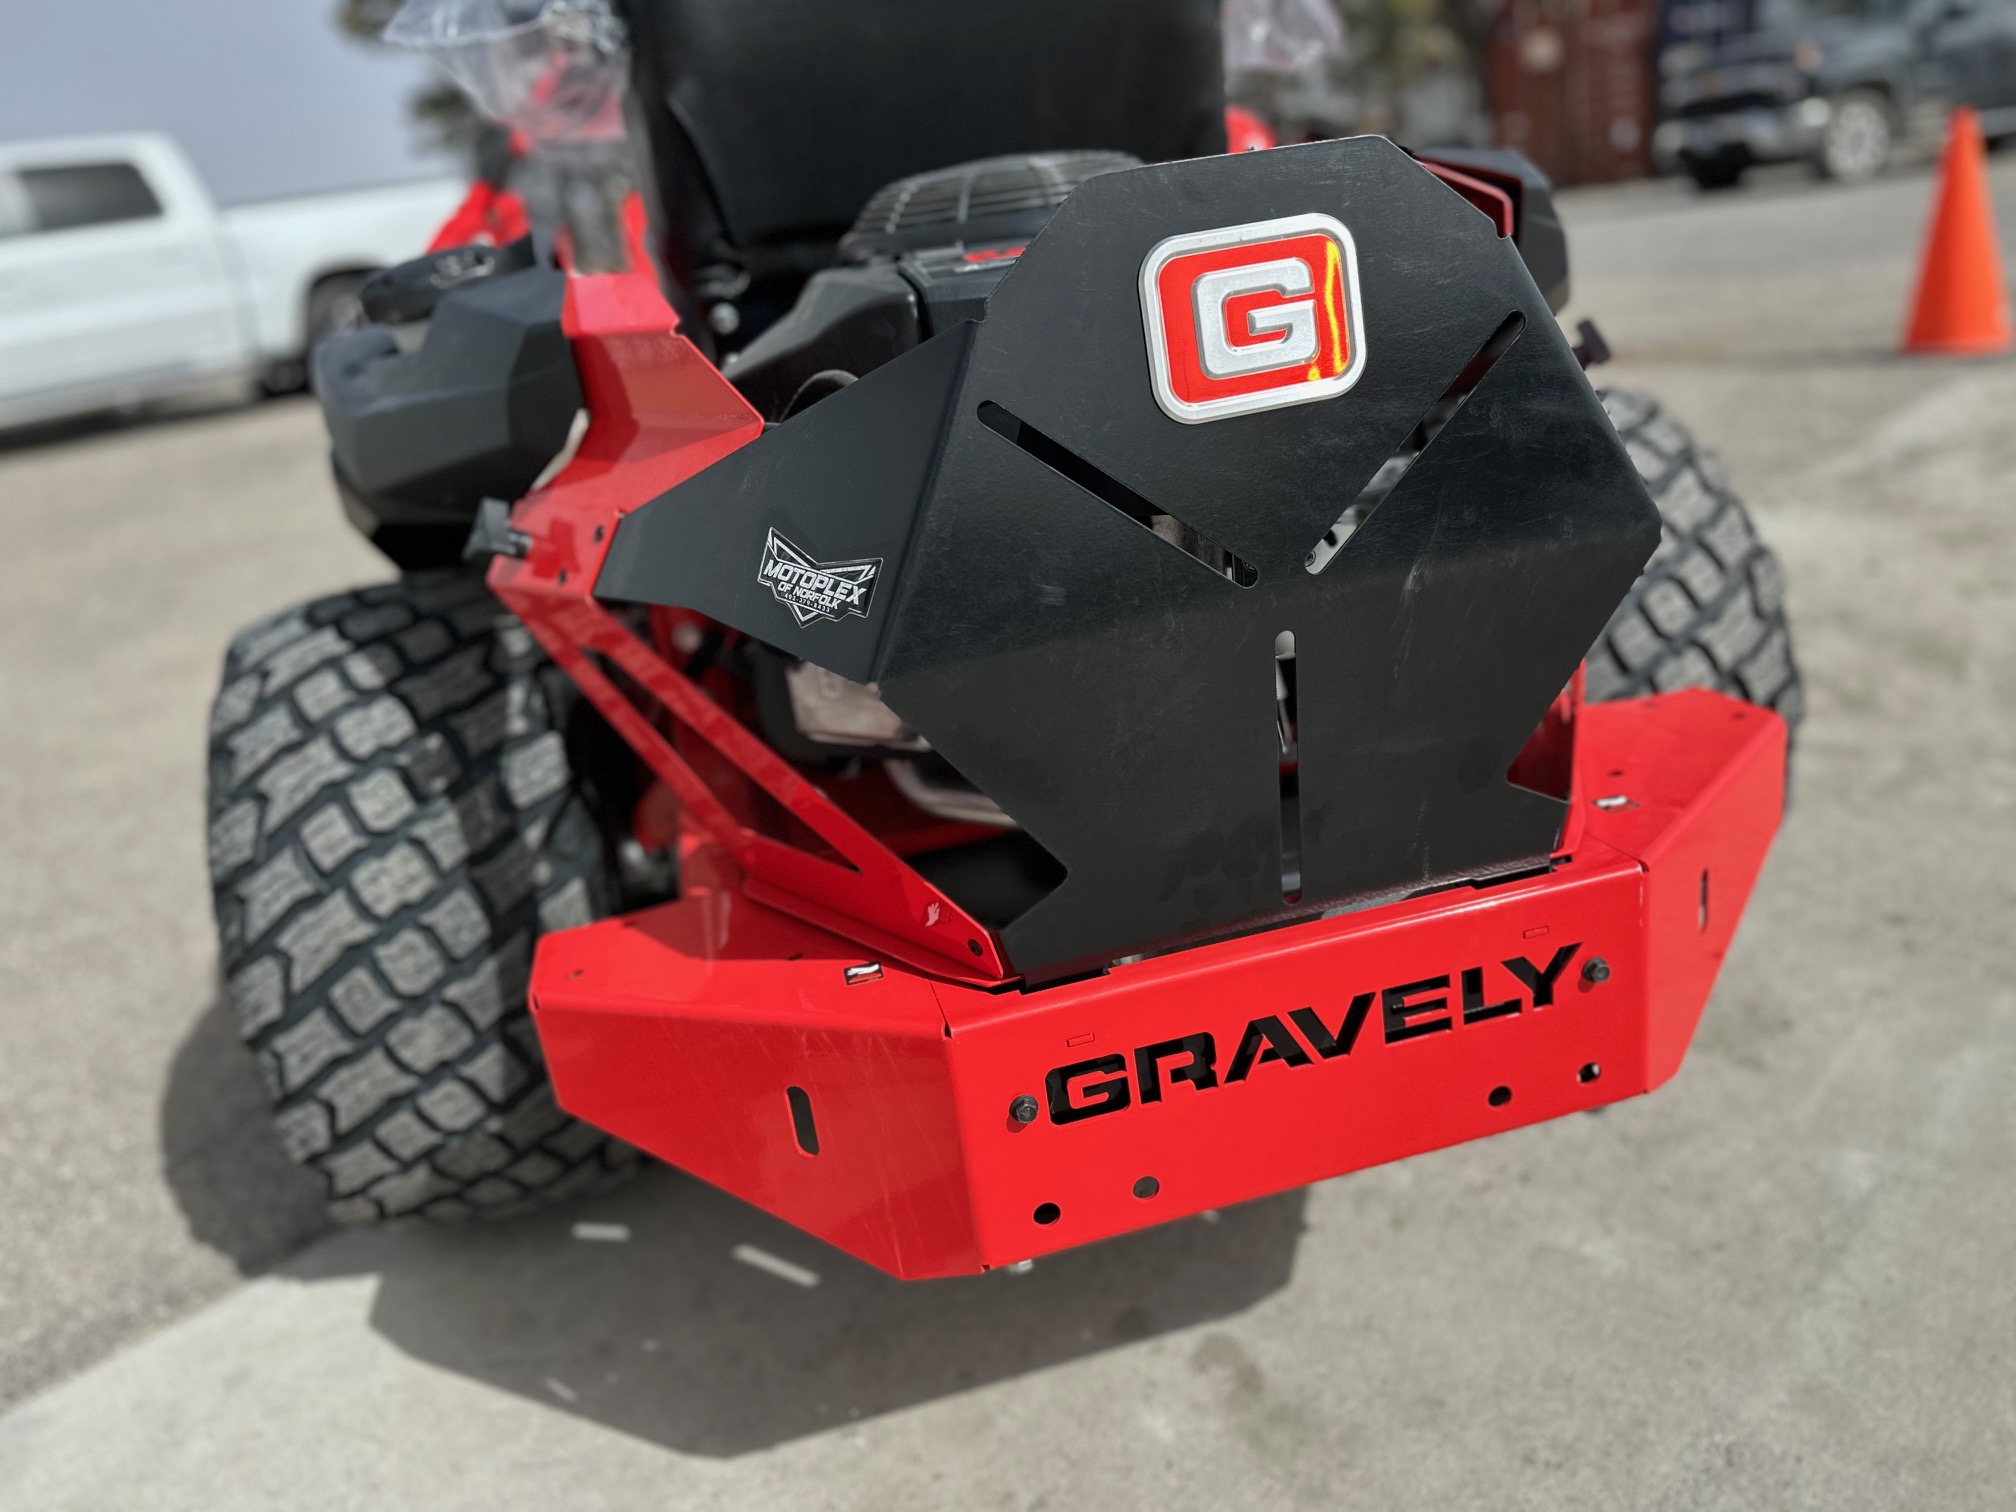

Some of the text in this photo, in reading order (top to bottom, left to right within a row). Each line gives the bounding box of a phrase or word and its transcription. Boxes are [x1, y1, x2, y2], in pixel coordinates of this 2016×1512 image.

[1191, 257, 1321, 380] G
[763, 559, 867, 605] MOTOPLEX
[777, 581, 841, 610] OF NORFOLK
[1045, 942, 1583, 1125] GRAVELY
